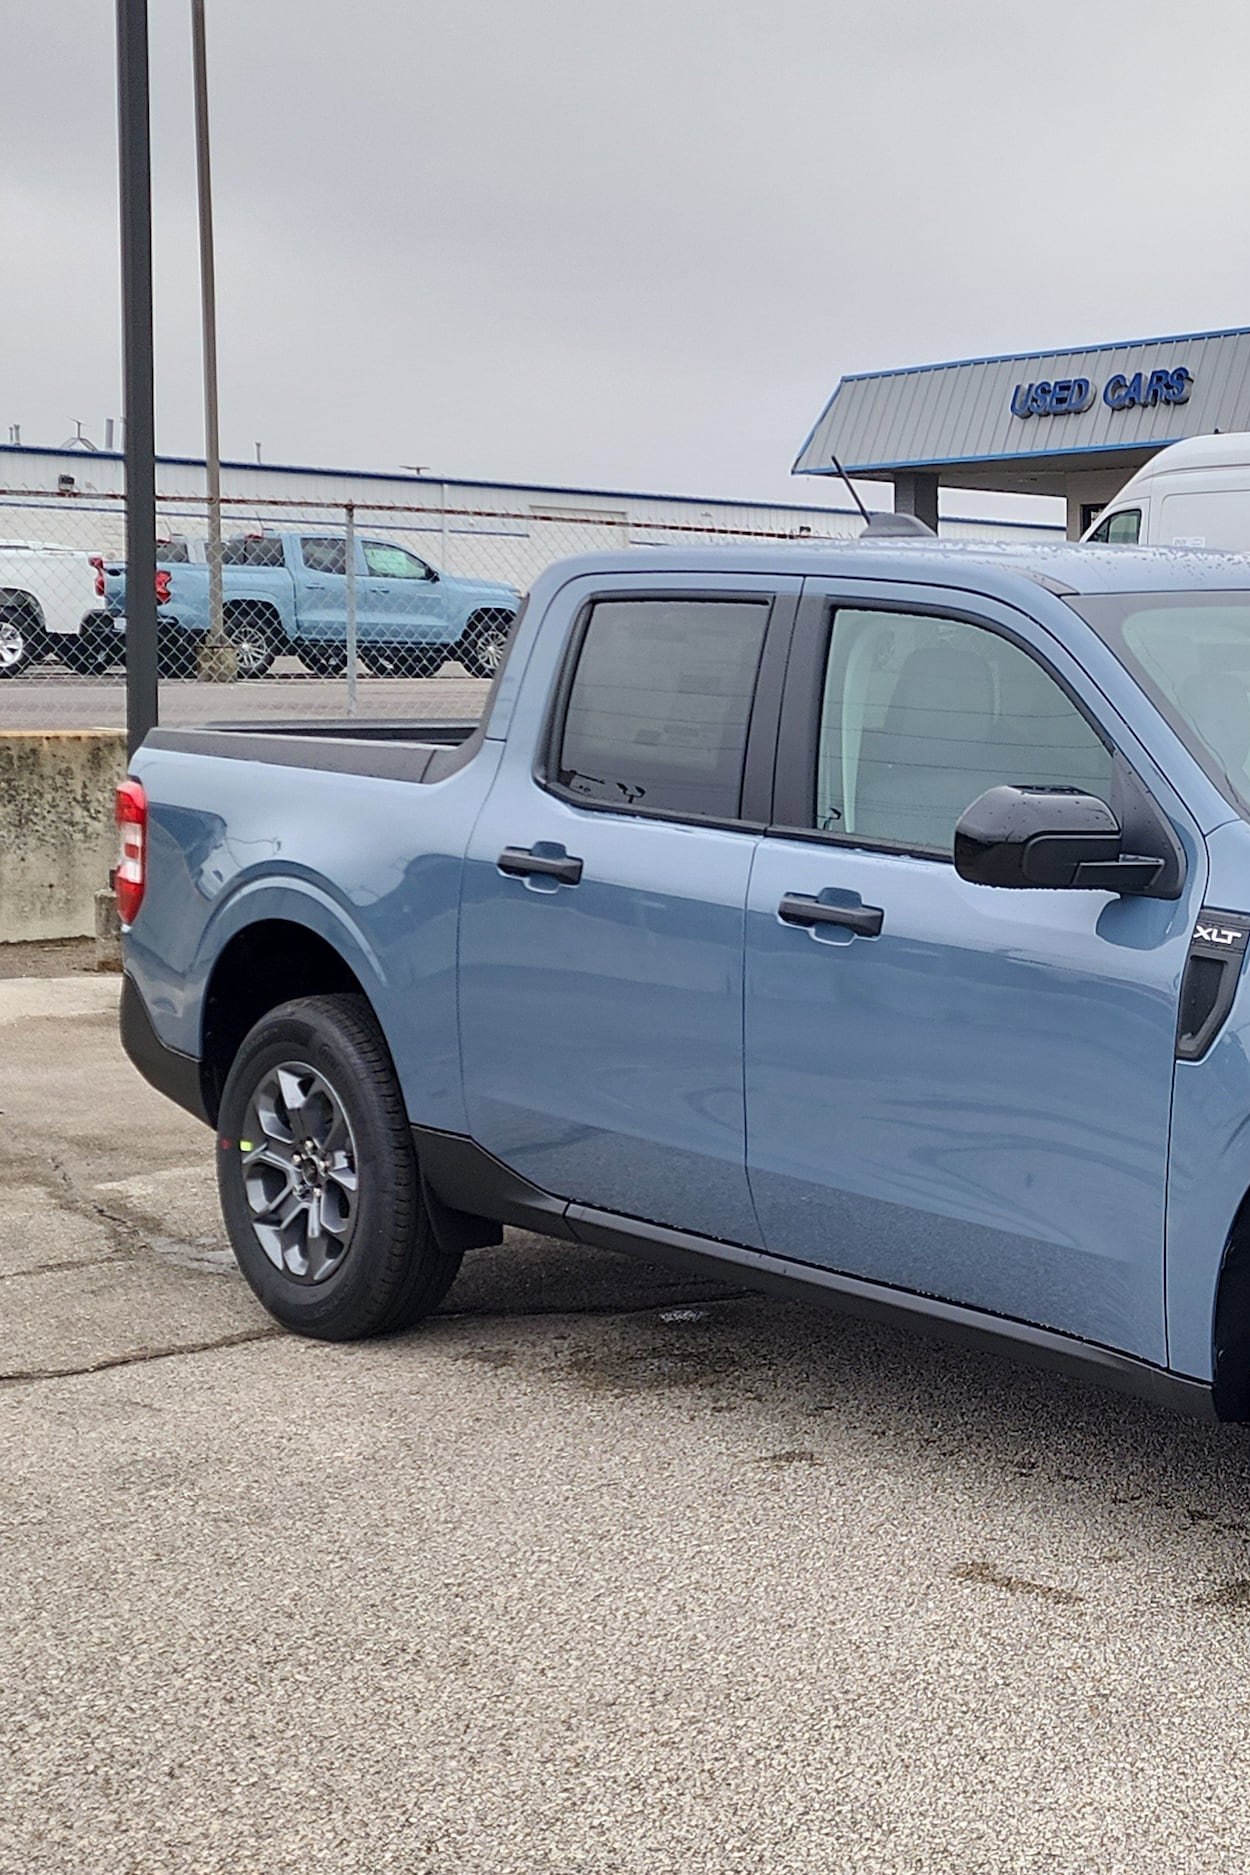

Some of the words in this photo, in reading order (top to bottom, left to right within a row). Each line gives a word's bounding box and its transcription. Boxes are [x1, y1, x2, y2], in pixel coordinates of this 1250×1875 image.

[1010, 378, 1096, 419] USED
[1103, 366, 1194, 411] CARS
[1193, 925, 1242, 944] XLT
